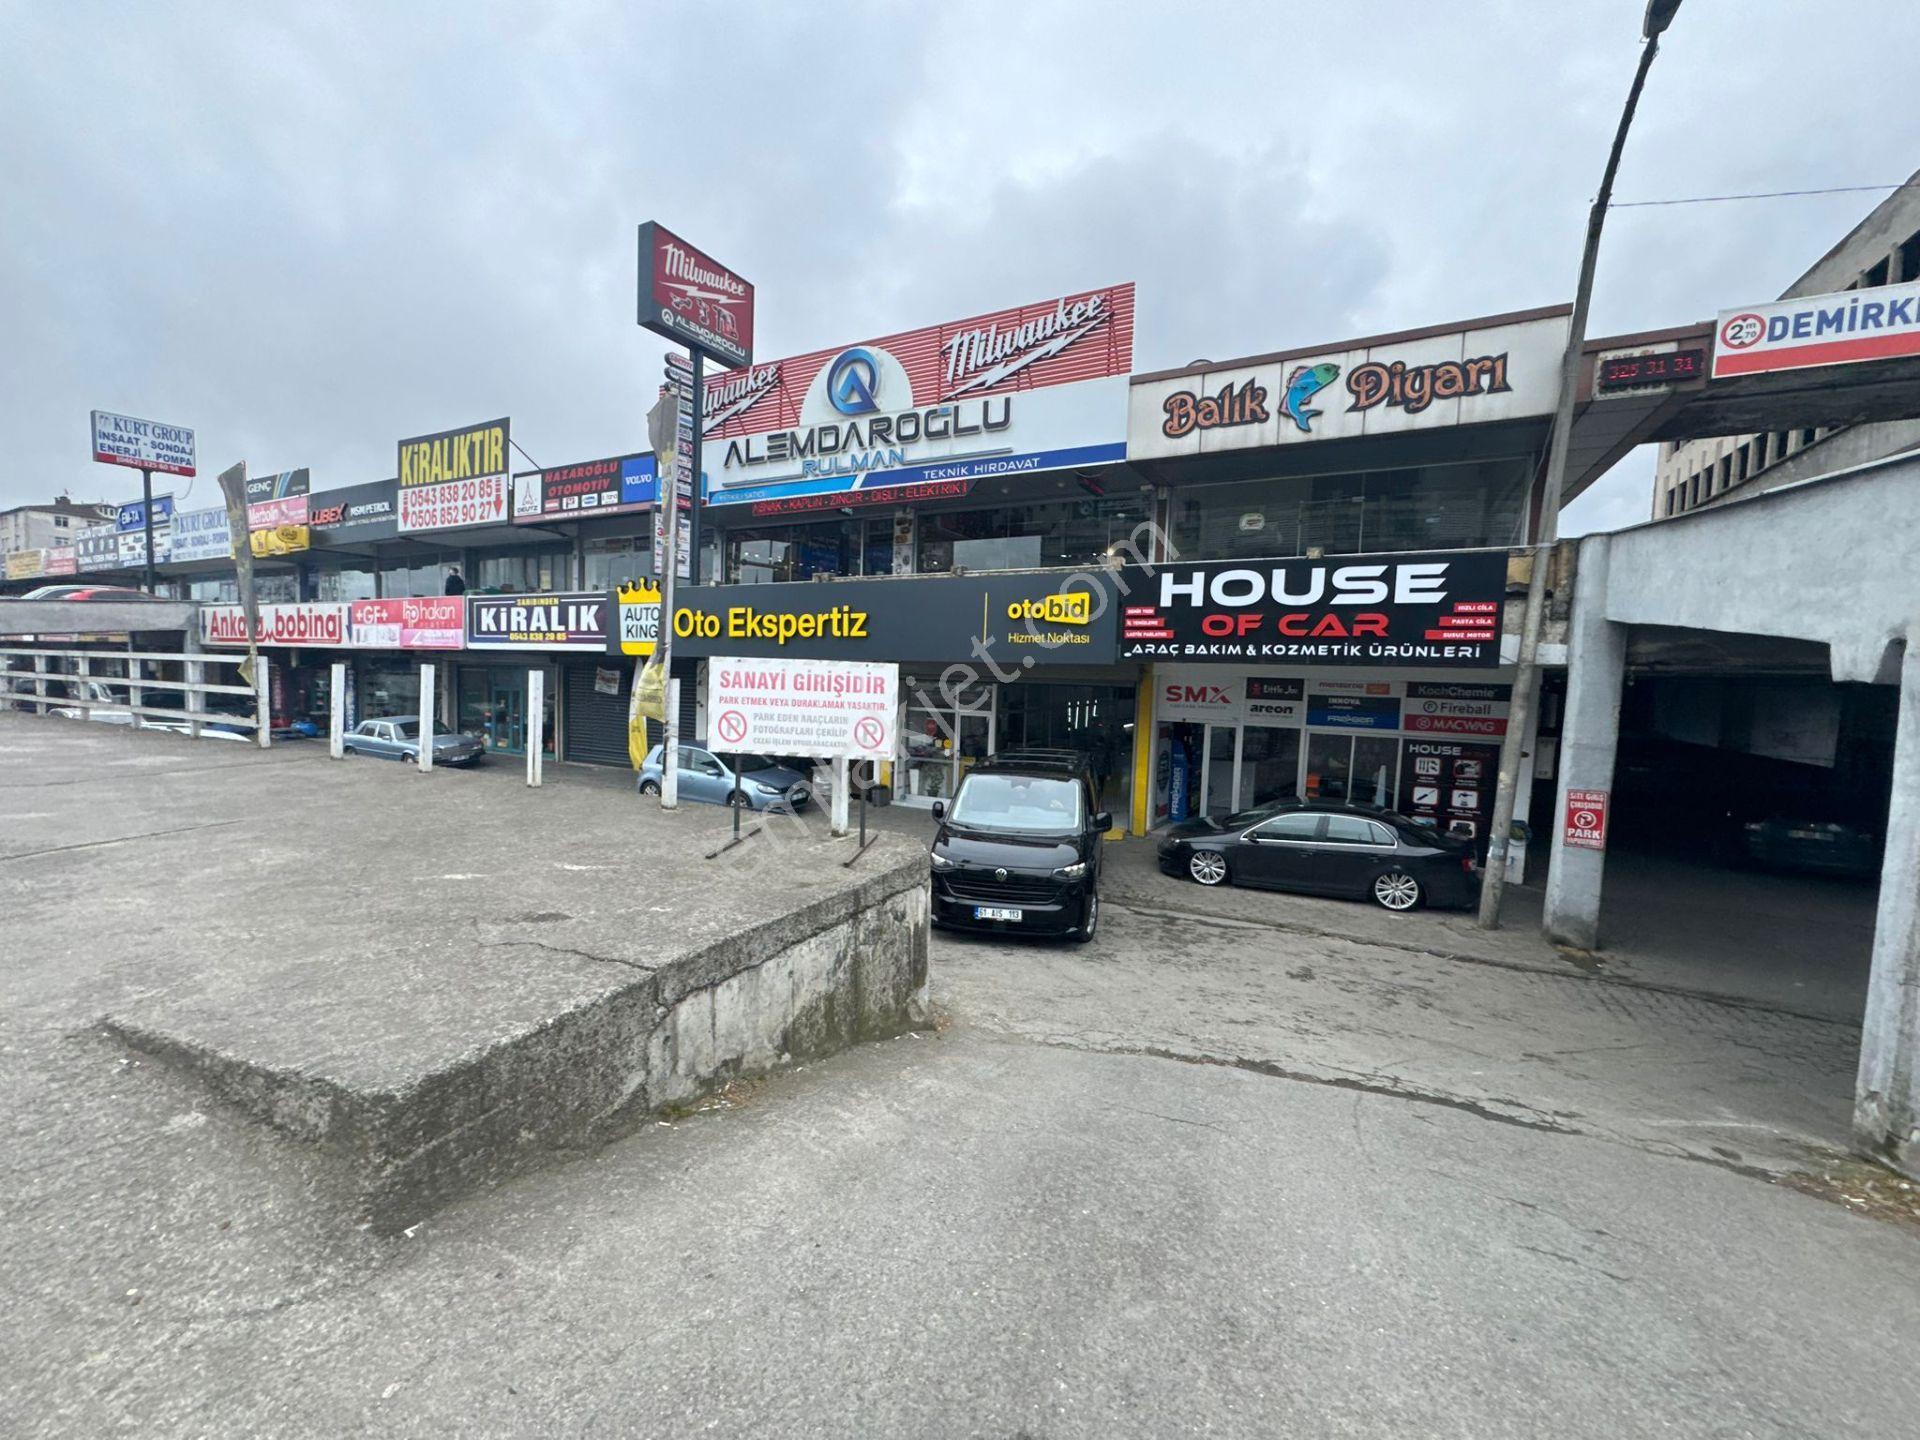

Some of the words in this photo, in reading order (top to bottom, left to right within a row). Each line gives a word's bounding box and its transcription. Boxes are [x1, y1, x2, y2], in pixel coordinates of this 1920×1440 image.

[660, 243, 745, 296] Milwaukee
[941, 294, 1108, 383] Milwaukee
[703, 364, 779, 416] lwaukee
[1163, 377, 1270, 438] Balık
[1346, 352, 1513, 413] Diyarı
[114, 417, 149, 437] KURT
[152, 423, 192, 445] GROUP
[151, 440, 193, 456] SONDAJ
[156, 452, 192, 466] POMPA
[802, 448, 907, 478] RULMAN
[923, 464, 970, 480] TEKNİK
[974, 457, 1042, 474] HIRDAVAT
[625, 474, 652, 485] VOLVO
[410, 487, 437, 508] 0543
[440, 484, 459, 504] 838
[462, 481, 476, 501] 20
[479, 479, 493, 499] 85
[310, 503, 348, 526] LUBEX
[410, 508, 438, 528] 0506
[440, 505, 459, 525] 852
[462, 503, 476, 522] 90
[479, 500, 493, 520] 27
[1160, 563, 1451, 607] HOUSE
[420, 600, 456, 619] hakan
[625, 606, 661, 622] AUTO
[1007, 597, 1085, 619] otobid
[210, 609, 263, 637] Ankaa
[276, 606, 343, 642] bobinaj
[626, 624, 658, 639] KING
[673, 608, 720, 638] Oto
[728, 605, 868, 645] Ekspertiz
[1202, 614, 1265, 637] OF
[1278, 613, 1390, 637] CAR
[1008, 633, 1045, 643] Hizmet
[1047, 632, 1090, 643] Noktası
[1132, 643, 1179, 658] ARAÇ
[1185, 643, 1241, 656] BAKIM
[1248, 644, 1256, 656] &
[1262, 641, 1362, 657] KOZMETİK
[1369, 642, 1481, 658] ÜRÜNLERİ
[719, 669, 786, 690] SANAYİ
[793, 671, 885, 698] GİRİŞİDİR
[1166, 685, 1232, 704] SMX
[719, 696, 739, 704] PARK
[741, 697, 768, 706] ETMEK
[770, 698, 789, 707] VEYA
[1250, 704, 1293, 714] areon
[1440, 702, 1492, 715] Fireball
[753, 712, 775, 721] PARK
[777, 713, 799, 722] EDEN
[1409, 744, 1462, 756] HOUSE
[1567, 827, 1602, 839] PARK
